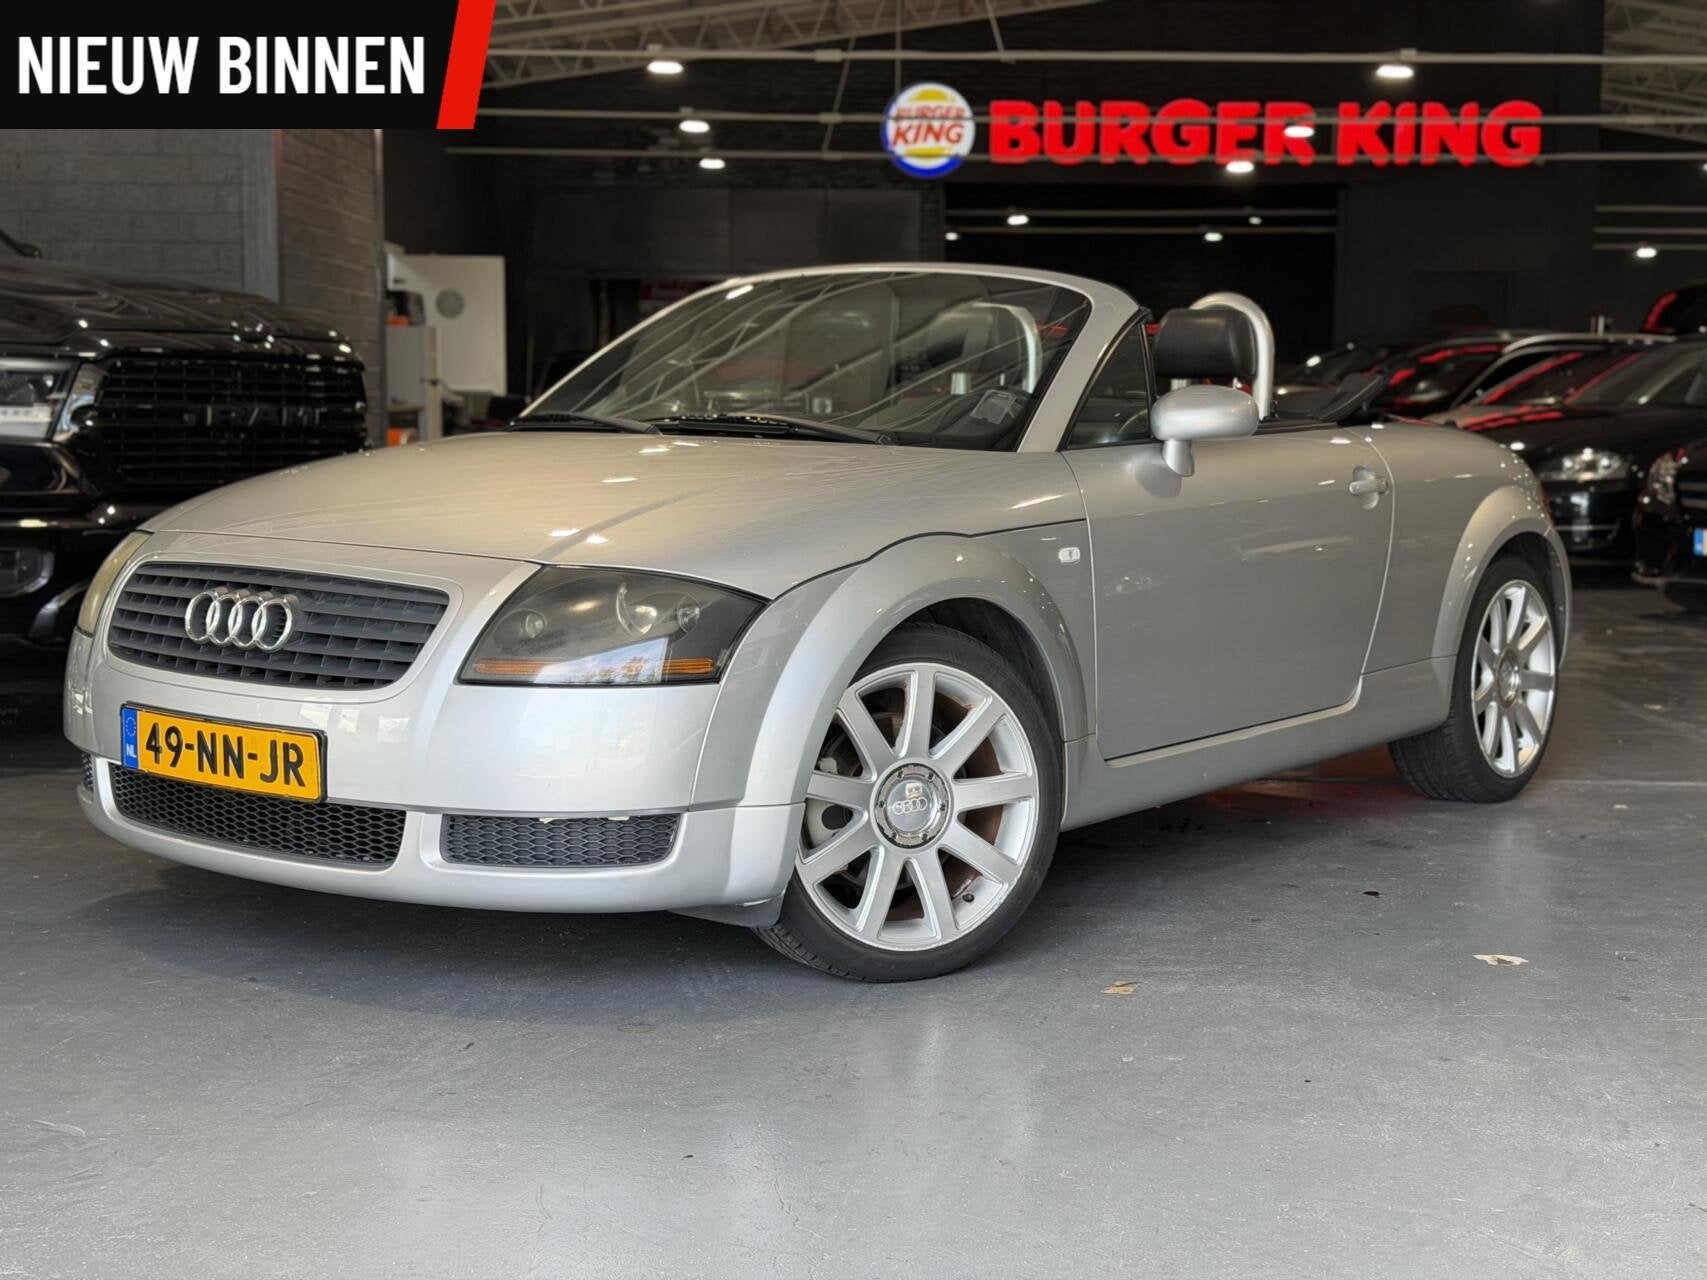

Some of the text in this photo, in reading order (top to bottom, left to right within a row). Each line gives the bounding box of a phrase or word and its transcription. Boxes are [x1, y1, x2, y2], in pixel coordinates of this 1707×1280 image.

[895, 105, 966, 120] BURGER
[892, 122, 964, 146] KING
[989, 98, 1544, 167] BURGER KING
[206, 404, 321, 427] RAM
[126, 743, 137, 758] NL
[145, 722, 306, 788] 49-NN-JR
